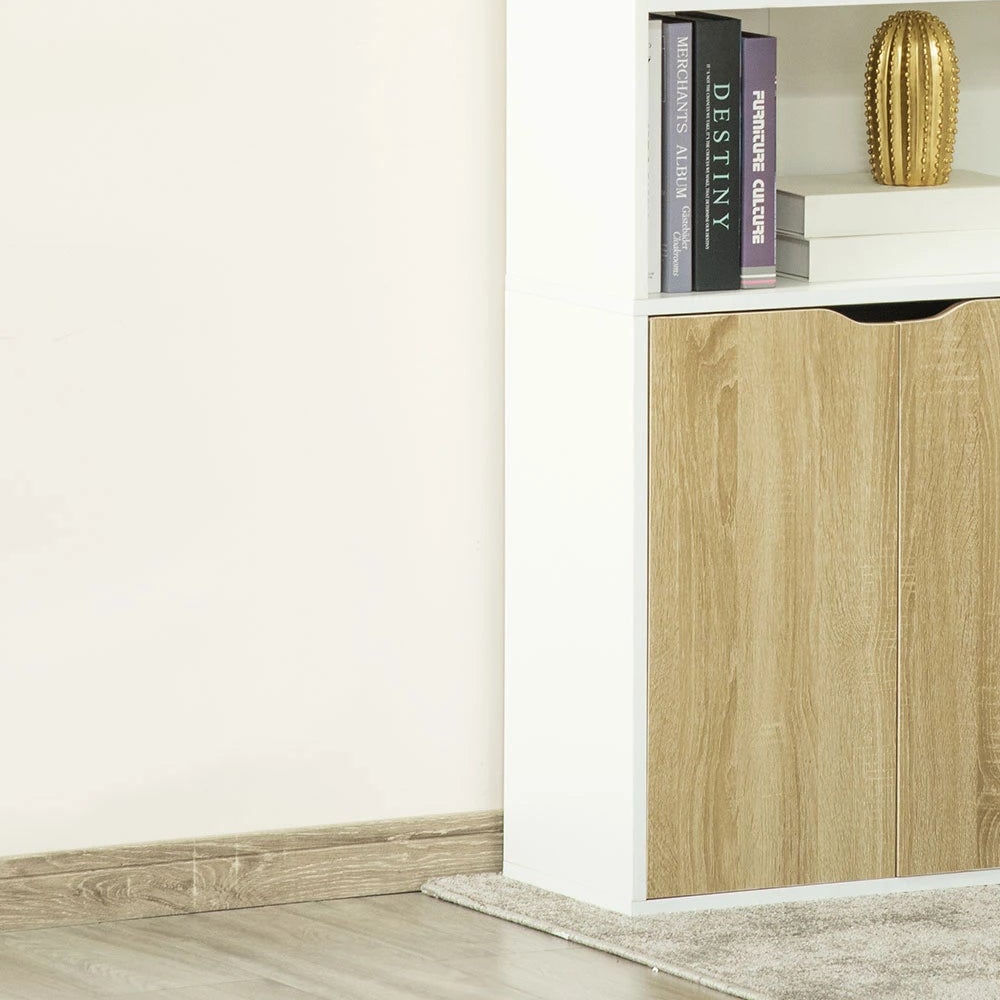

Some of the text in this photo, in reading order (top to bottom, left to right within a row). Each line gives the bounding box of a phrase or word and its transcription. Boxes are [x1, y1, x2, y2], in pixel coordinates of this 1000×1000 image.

[675, 36, 688, 199] MERCHANTS ALBUM
[713, 83, 730, 231] DESTINY
[672, 231, 682, 277] Cloakrooms
[752, 179, 765, 244] CULTURE
